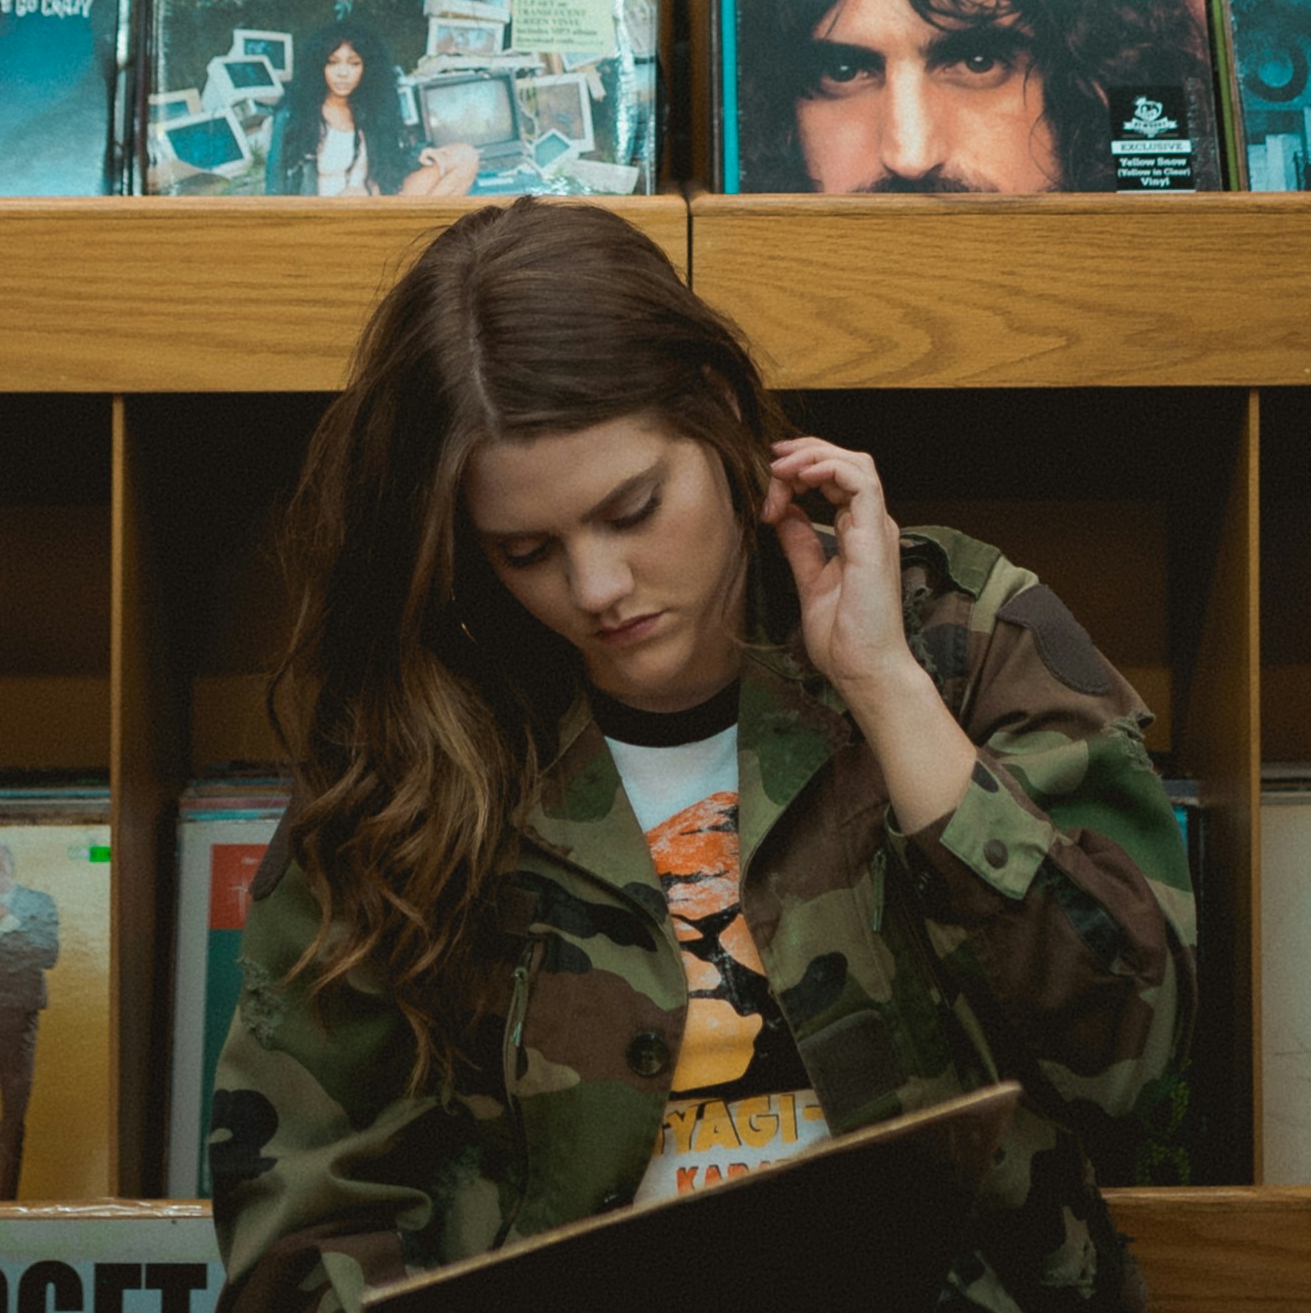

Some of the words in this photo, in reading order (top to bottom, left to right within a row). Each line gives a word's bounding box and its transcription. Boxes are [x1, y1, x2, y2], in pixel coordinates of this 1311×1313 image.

[1120, 142, 1183, 151] EXCLUSIVE
[1119, 156, 1156, 167] Yellow
[1156, 156, 1187, 167] Snow
[1117, 168, 1151, 178] (Yellow
[1140, 177, 1171, 188] Vinyl
